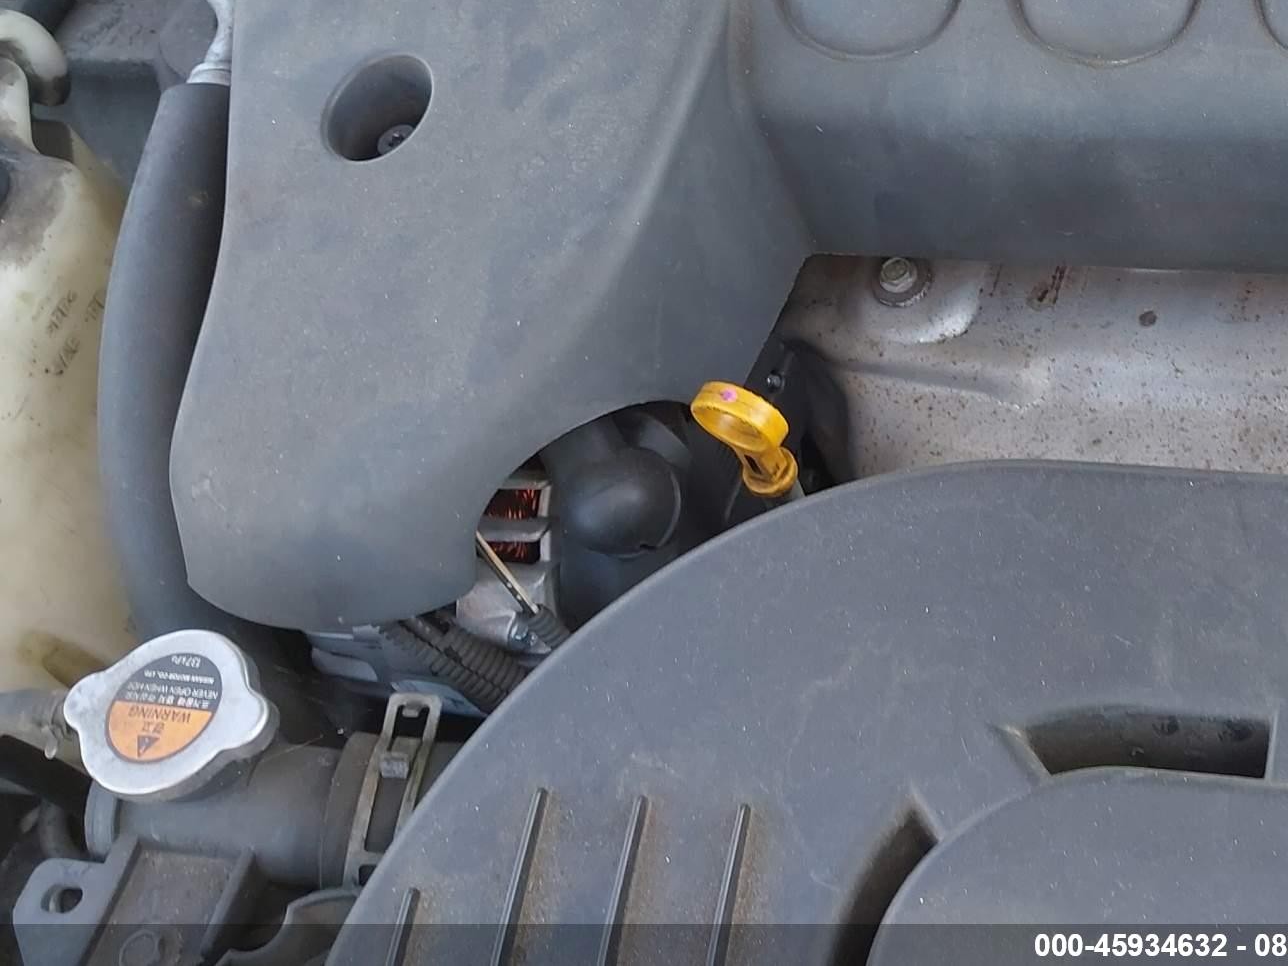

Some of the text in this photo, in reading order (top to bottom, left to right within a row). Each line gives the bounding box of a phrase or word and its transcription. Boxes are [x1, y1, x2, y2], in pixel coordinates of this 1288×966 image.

[144, 683, 168, 694] WHEN
[169, 685, 191, 697] OPEN
[191, 688, 219, 699] NEVER
[128, 705, 191, 723] WARNING
